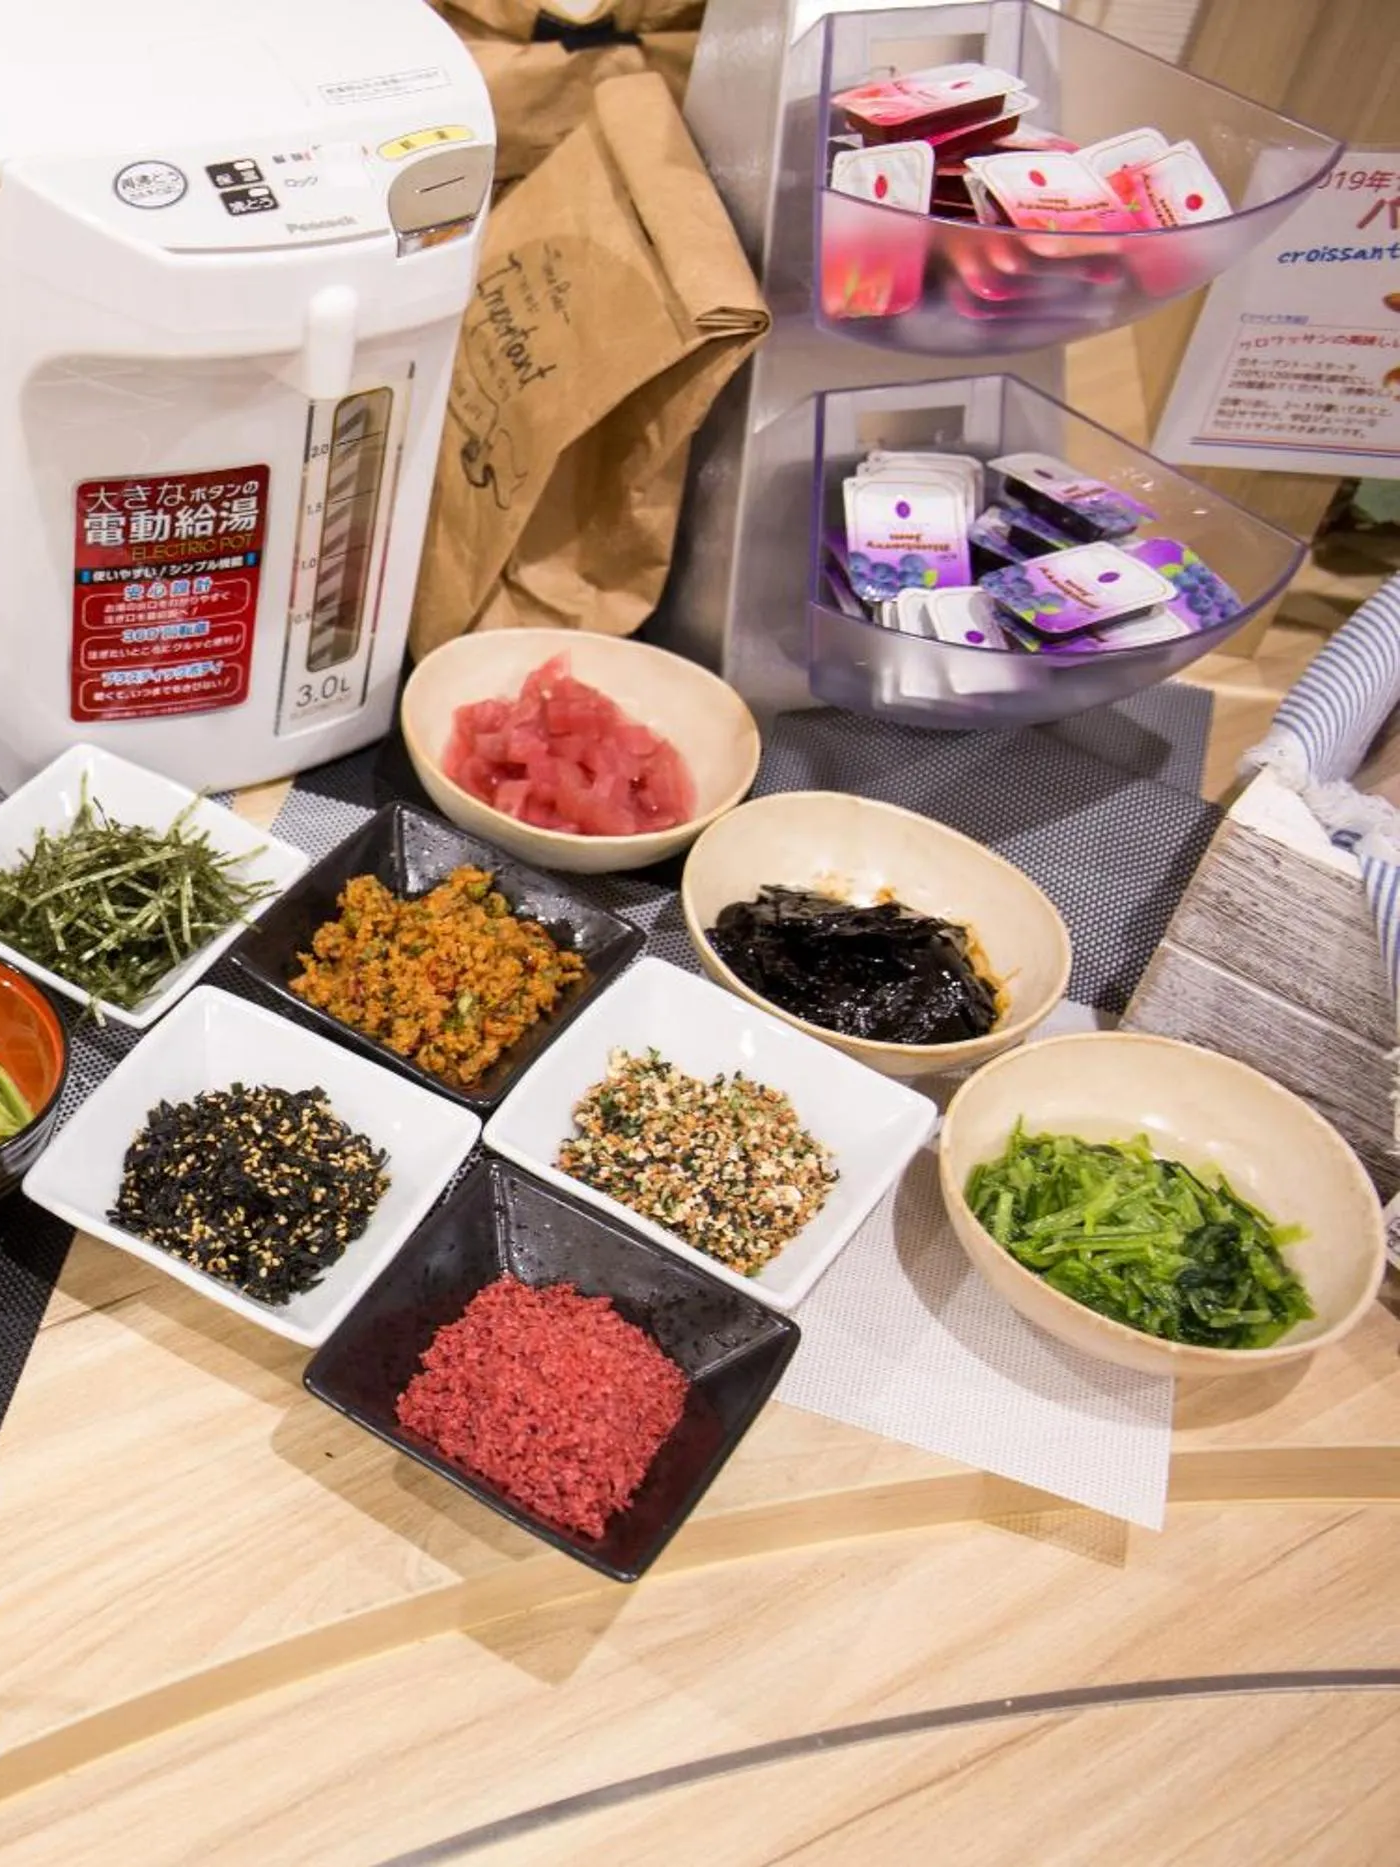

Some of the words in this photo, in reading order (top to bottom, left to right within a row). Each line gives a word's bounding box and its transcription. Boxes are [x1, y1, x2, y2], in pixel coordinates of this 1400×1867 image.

[1317, 170, 1400, 192] 19年
[86, 481, 259, 512] 大きなボタンの
[84, 497, 258, 546] 電動給湯
[132, 539, 217, 561] ELECTRIC
[219, 534, 255, 552] POT
